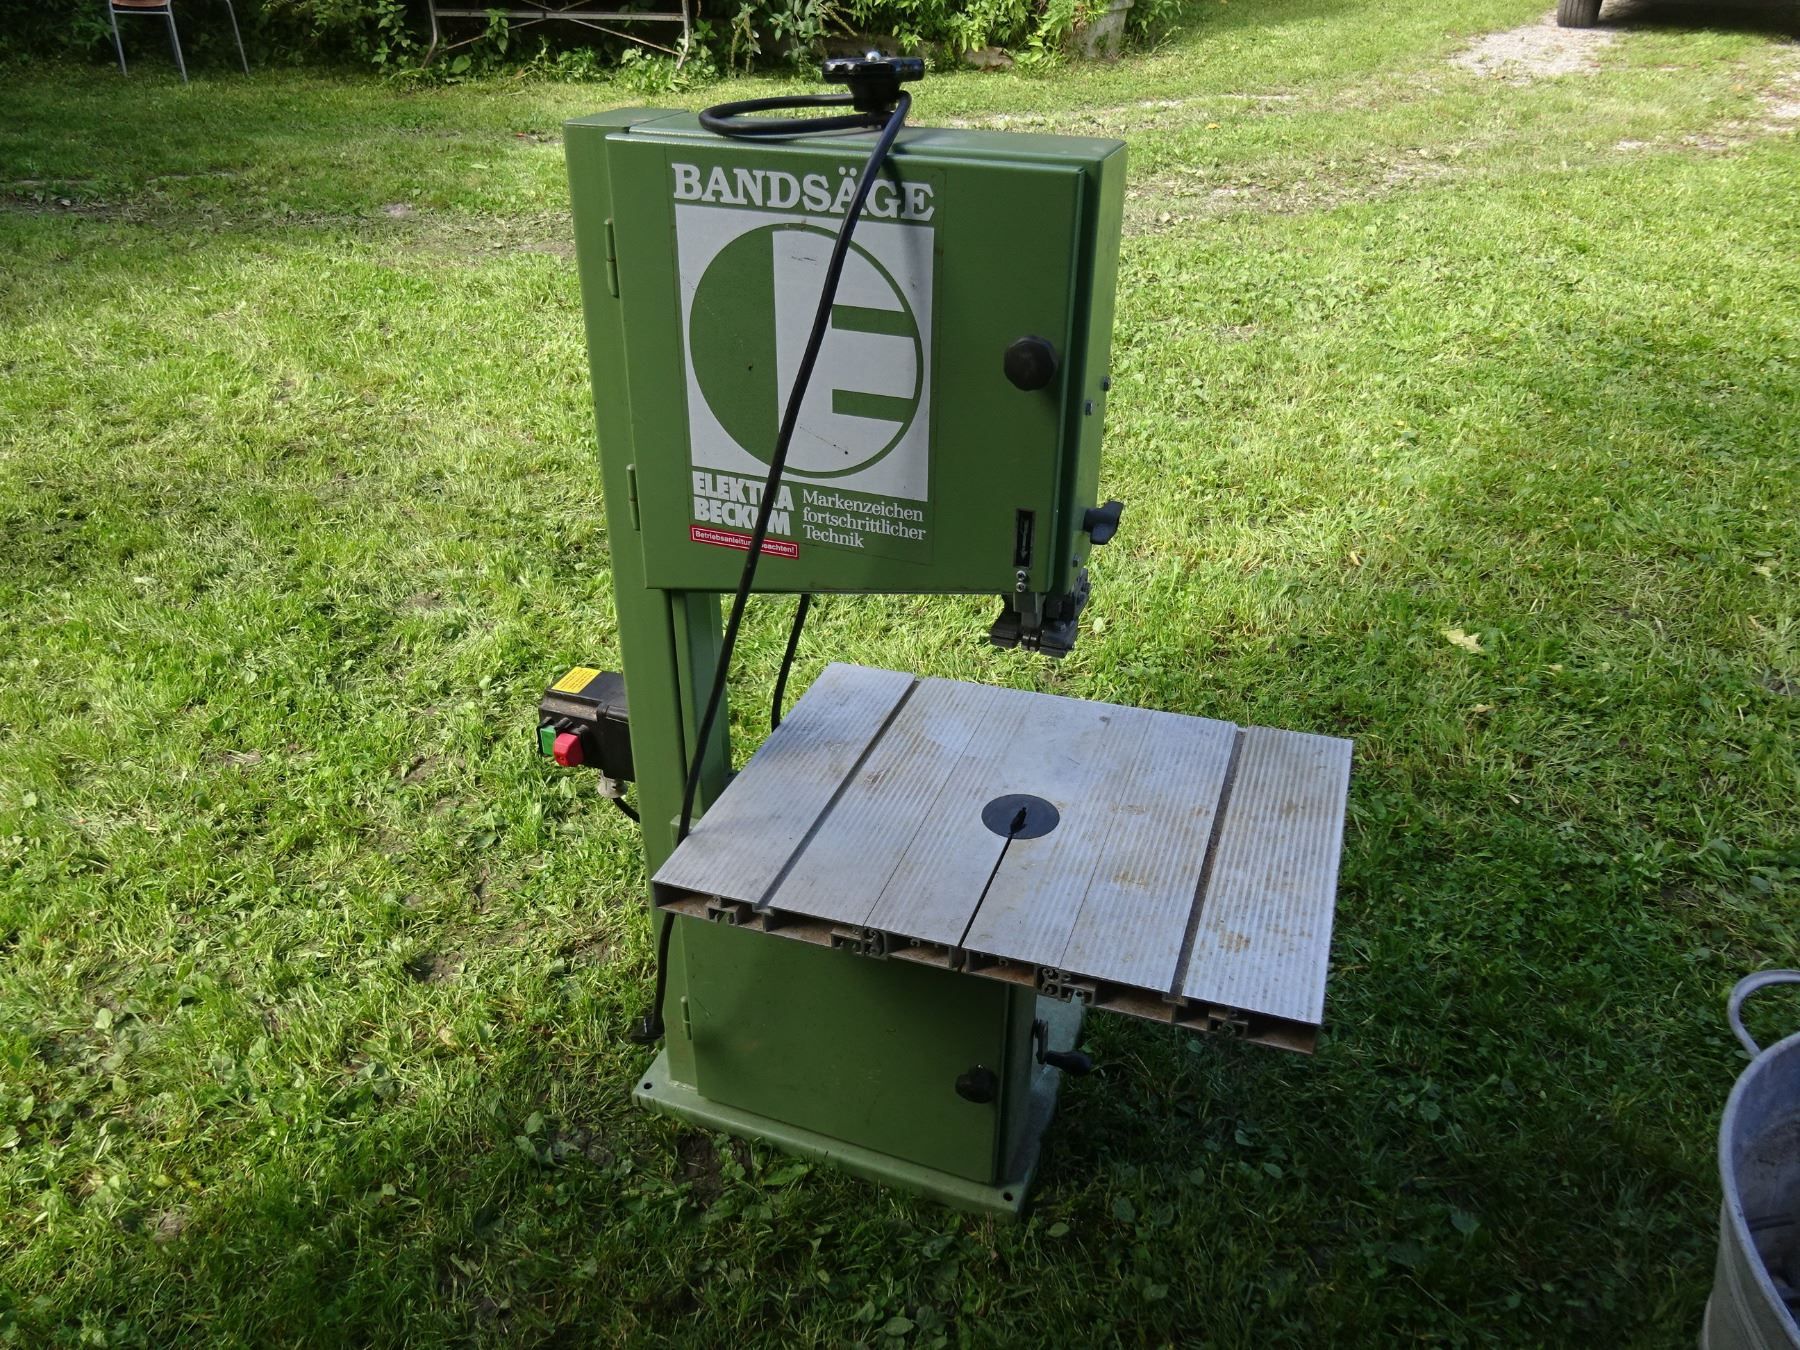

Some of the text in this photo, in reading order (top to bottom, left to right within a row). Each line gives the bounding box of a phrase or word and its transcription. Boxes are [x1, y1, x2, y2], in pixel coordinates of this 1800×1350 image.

[671, 163, 935, 222] BANDSÄGE
[802, 488, 924, 522] Markenzeichen
[802, 506, 927, 540] fortschrittlicher
[802, 525, 865, 549] Technik
[761, 543, 794, 554] eachten!
